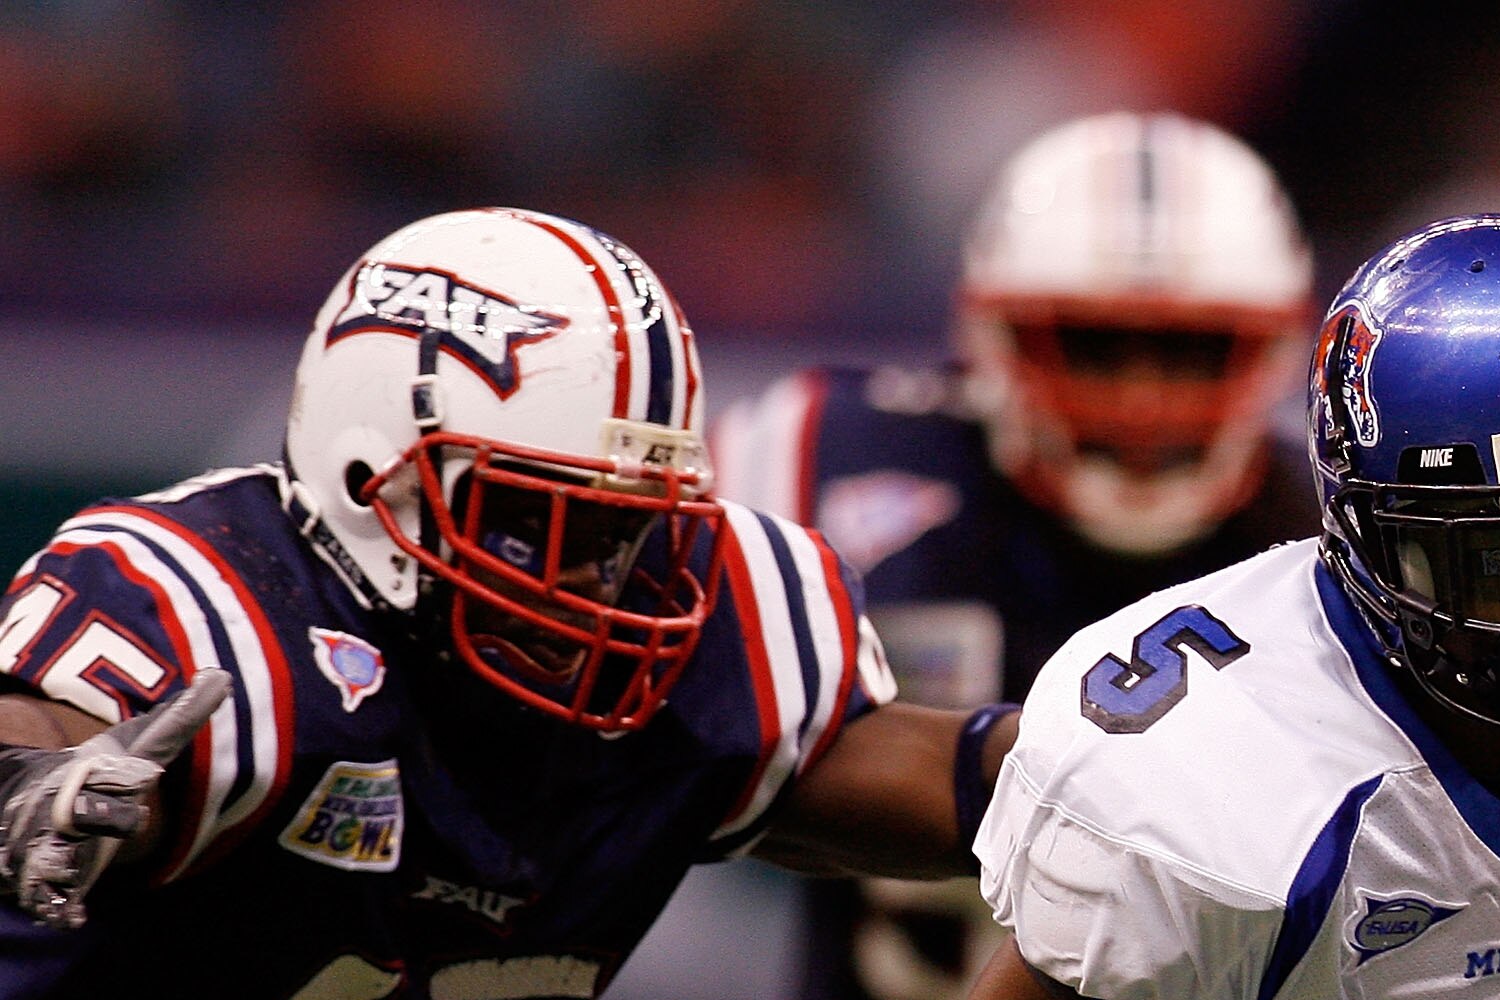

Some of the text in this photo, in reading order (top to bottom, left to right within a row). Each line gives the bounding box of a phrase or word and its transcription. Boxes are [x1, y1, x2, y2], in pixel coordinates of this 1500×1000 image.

[338, 270, 548, 364] FAU
[1420, 448, 1453, 468] NIKE
[1081, 604, 1251, 734] 5
[411, 877, 526, 922] FAU
